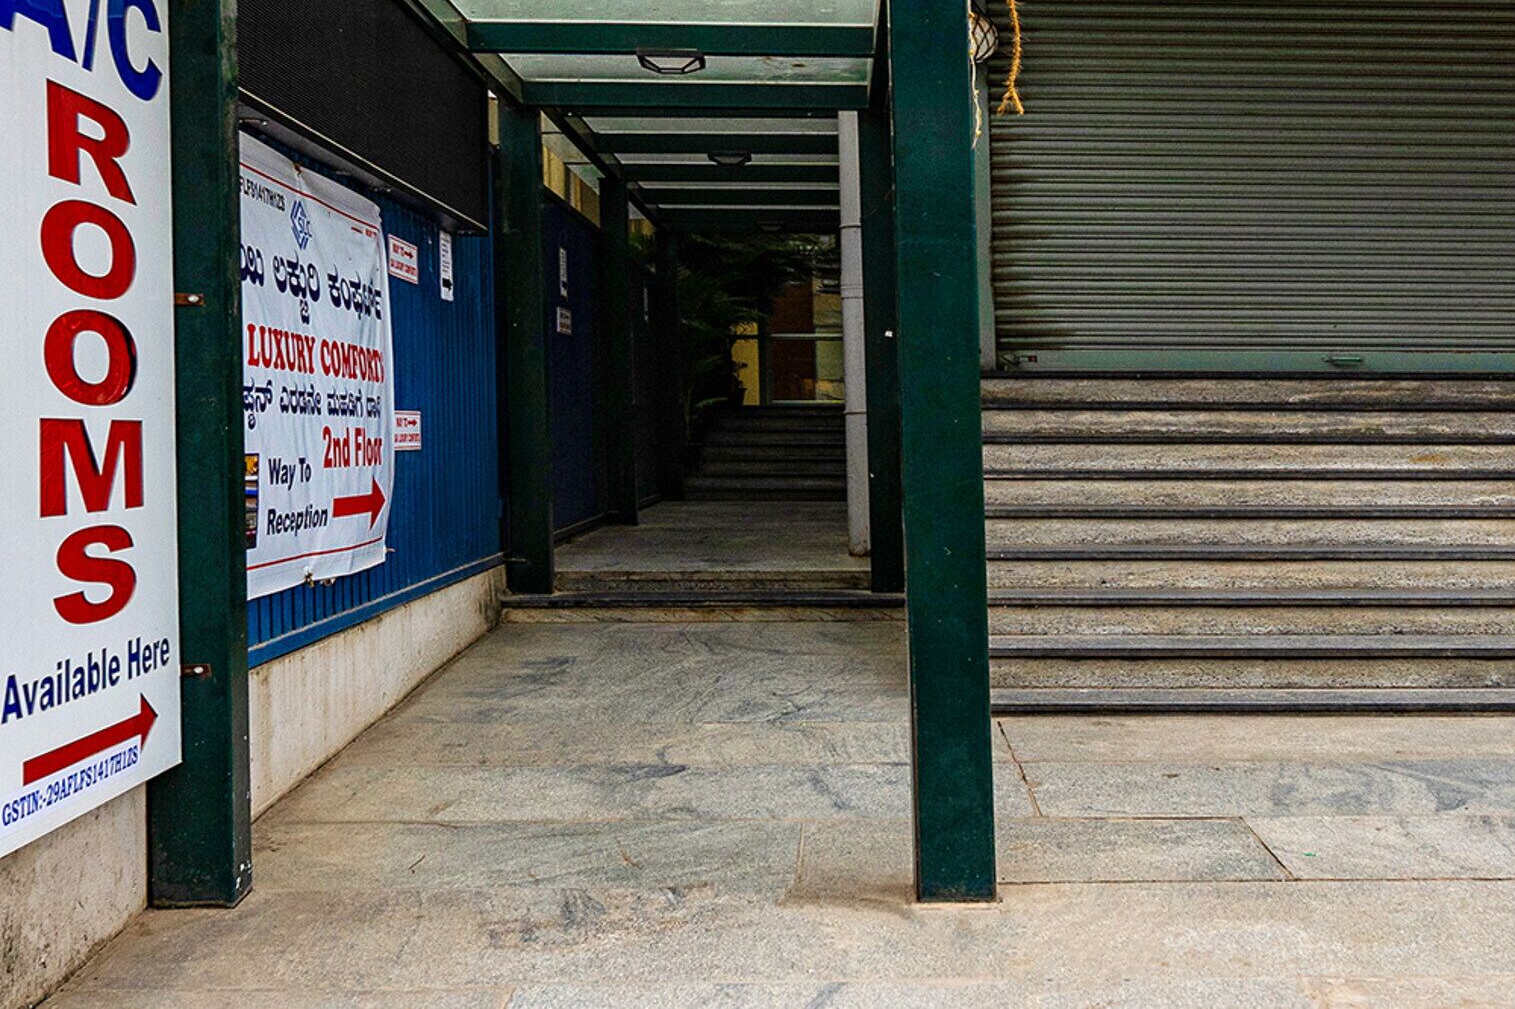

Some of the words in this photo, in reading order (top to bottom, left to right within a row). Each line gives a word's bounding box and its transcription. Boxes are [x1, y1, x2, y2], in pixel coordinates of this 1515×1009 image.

[40, 77, 147, 625] ROOMS
[247, 323, 316, 374] LUXURY
[322, 425, 351, 469] 2nd
[354, 426, 382, 468] Floor
[268, 457, 297, 491] Way
[298, 457, 312, 483] To
[266, 504, 328, 537] Reception
[1, 648, 121, 725] Available
[127, 636, 170, 680] Here
